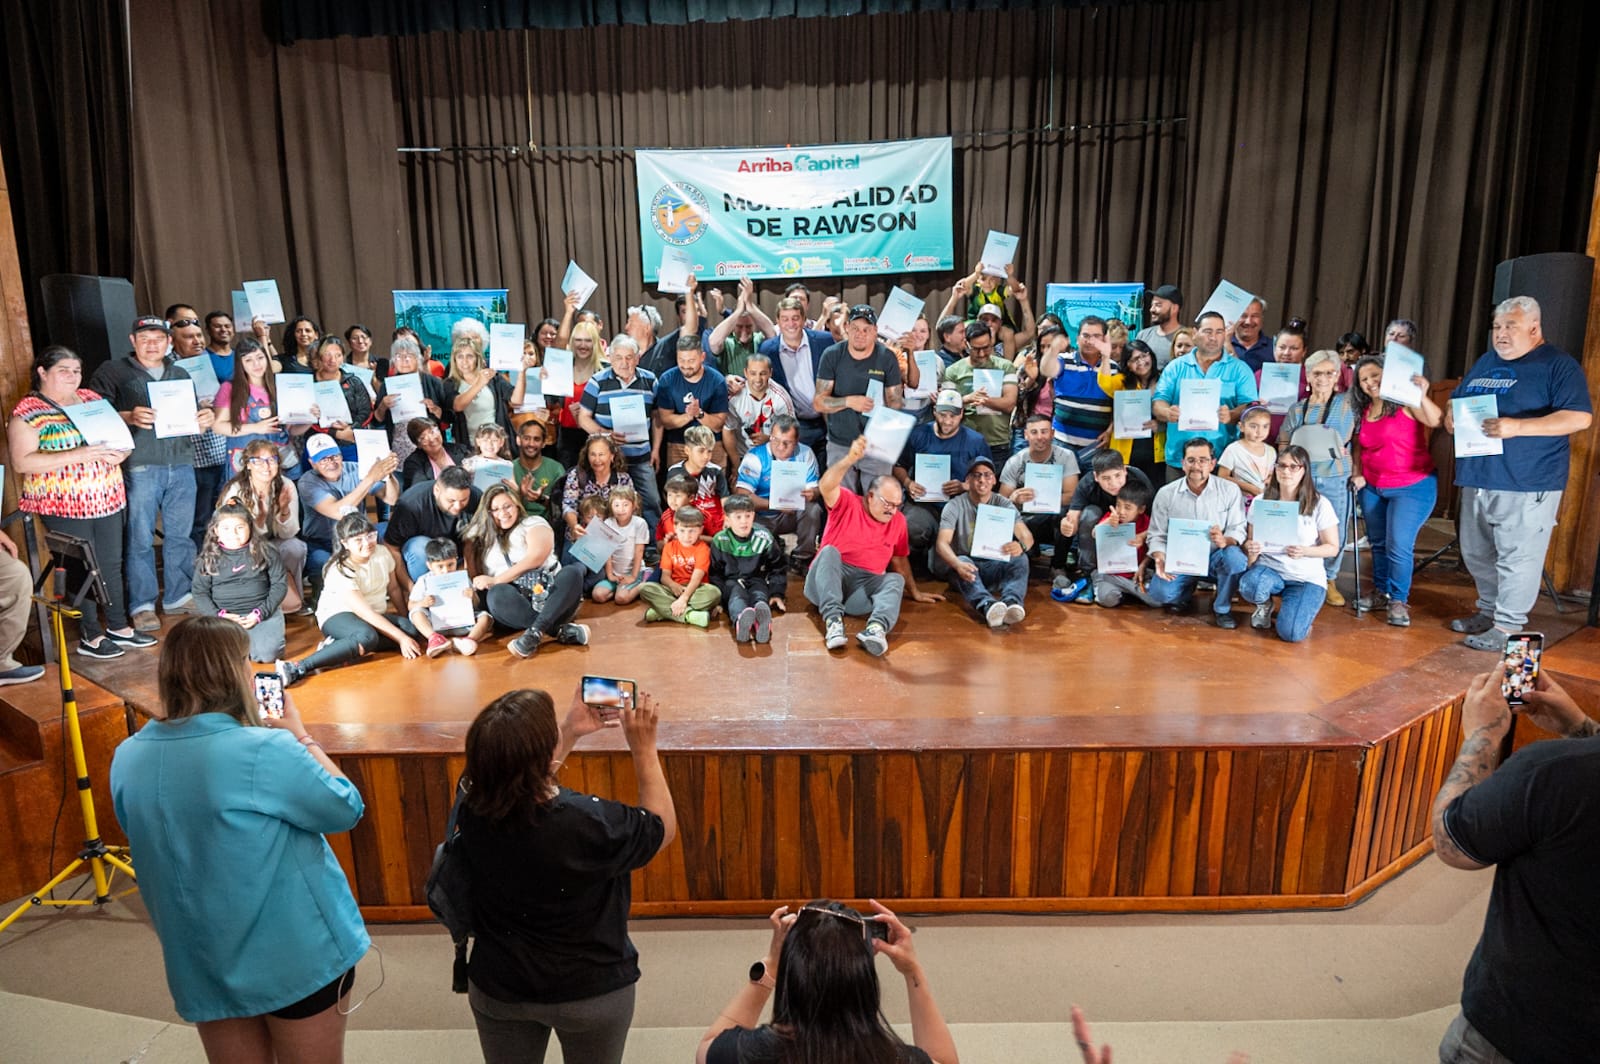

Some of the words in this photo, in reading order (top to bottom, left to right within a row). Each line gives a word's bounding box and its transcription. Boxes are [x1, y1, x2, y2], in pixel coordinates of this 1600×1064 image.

[738, 157, 793, 173] Arriba
[794, 153, 860, 175] Capital
[747, 217, 783, 237] DE
[794, 211, 917, 236] RAWSON
